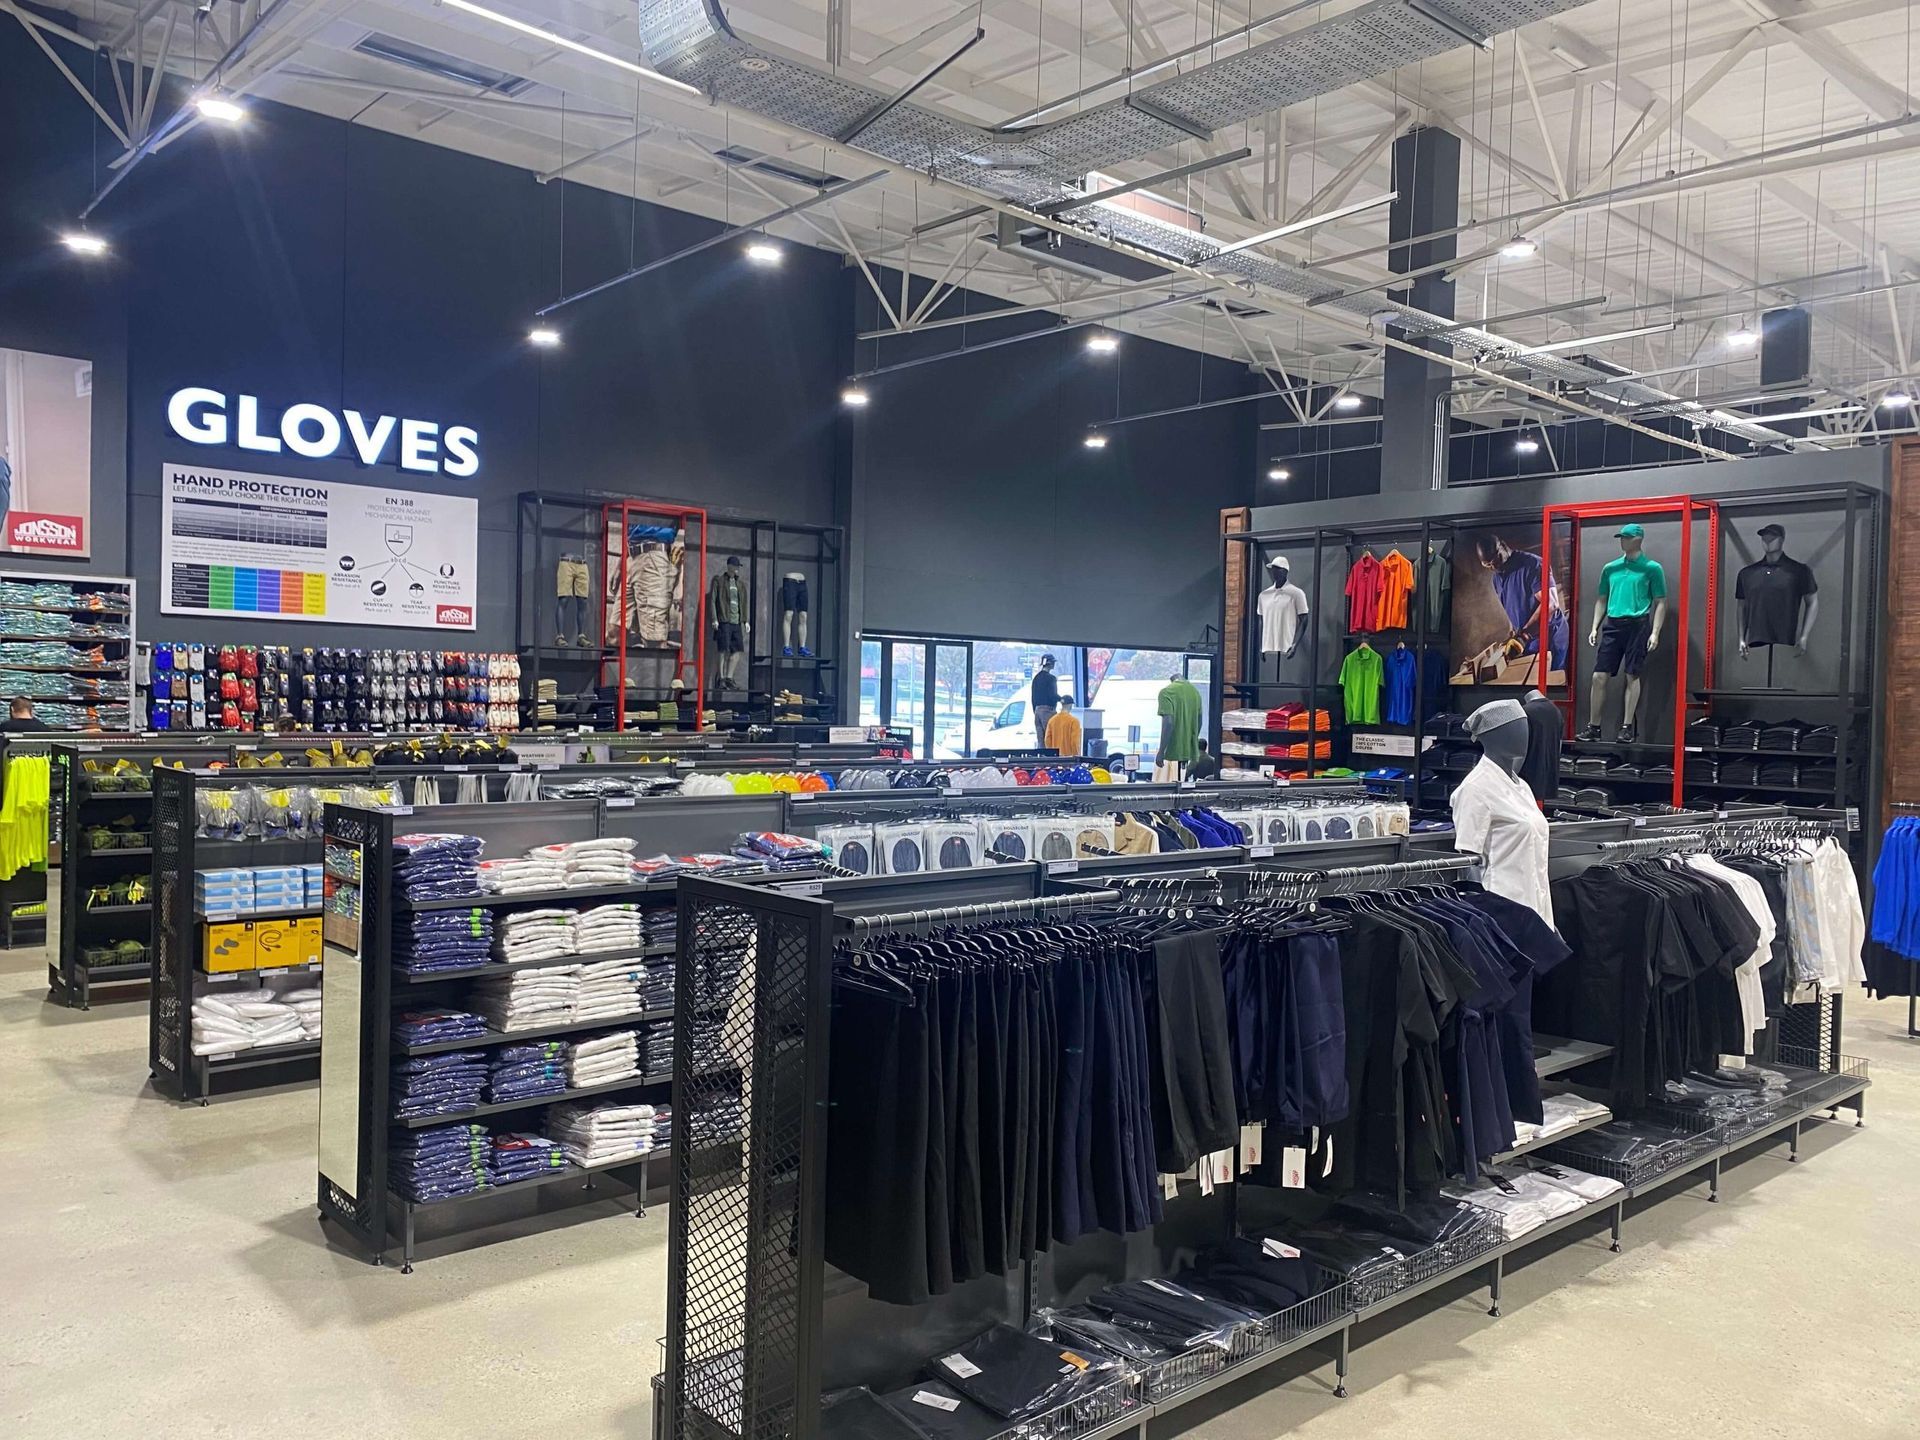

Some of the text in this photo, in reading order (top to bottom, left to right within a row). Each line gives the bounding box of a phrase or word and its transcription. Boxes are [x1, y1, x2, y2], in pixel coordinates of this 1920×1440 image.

[167, 386, 479, 477] GLOVES
[173, 473, 328, 500] HAND PROTECTION
[235, 491, 264, 500] CHOOSE
[385, 497, 414, 506] EN 388
[366, 504, 431, 516] PROTECTION AGAINST
[364, 512, 433, 524] MECHANICAL HAZARDS
[14, 518, 76, 540] JONSSON
[14, 535, 77, 546] WORKWEAR
[439, 608, 469, 619] JONSSON
